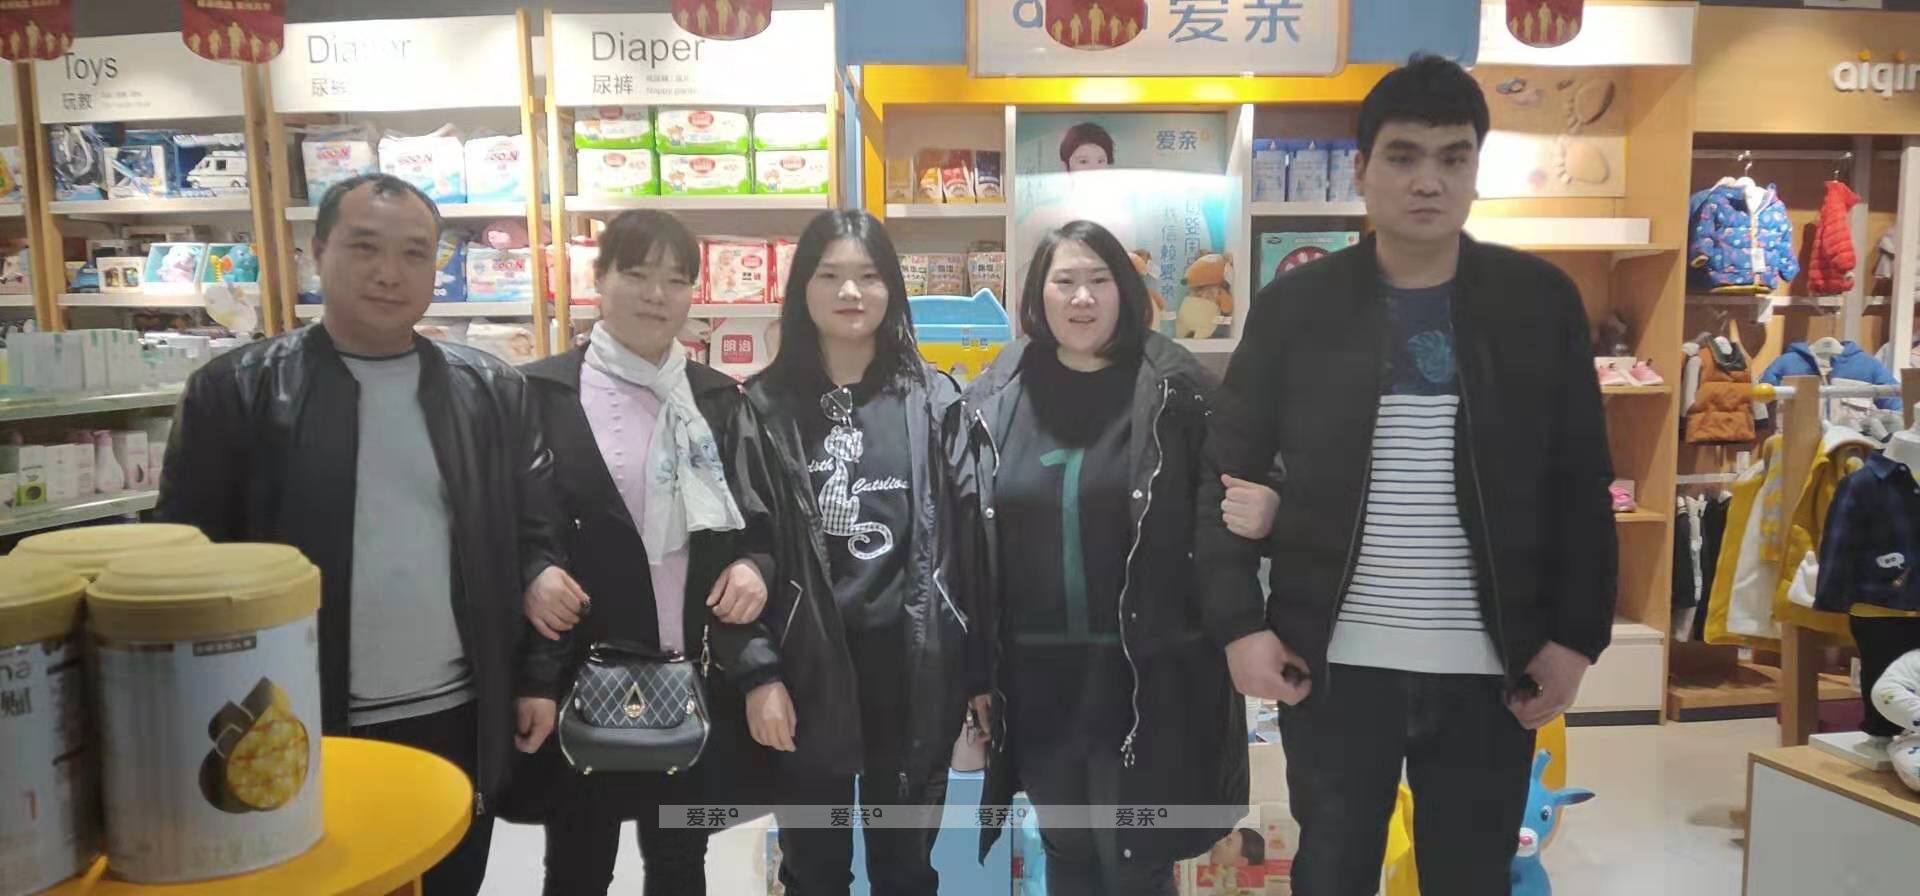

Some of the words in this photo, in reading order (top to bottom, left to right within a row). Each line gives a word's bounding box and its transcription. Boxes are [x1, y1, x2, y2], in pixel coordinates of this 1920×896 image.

[308, 35, 411, 64] Diar
[592, 31, 705, 68] Diaper
[64, 52, 118, 86] Toys
